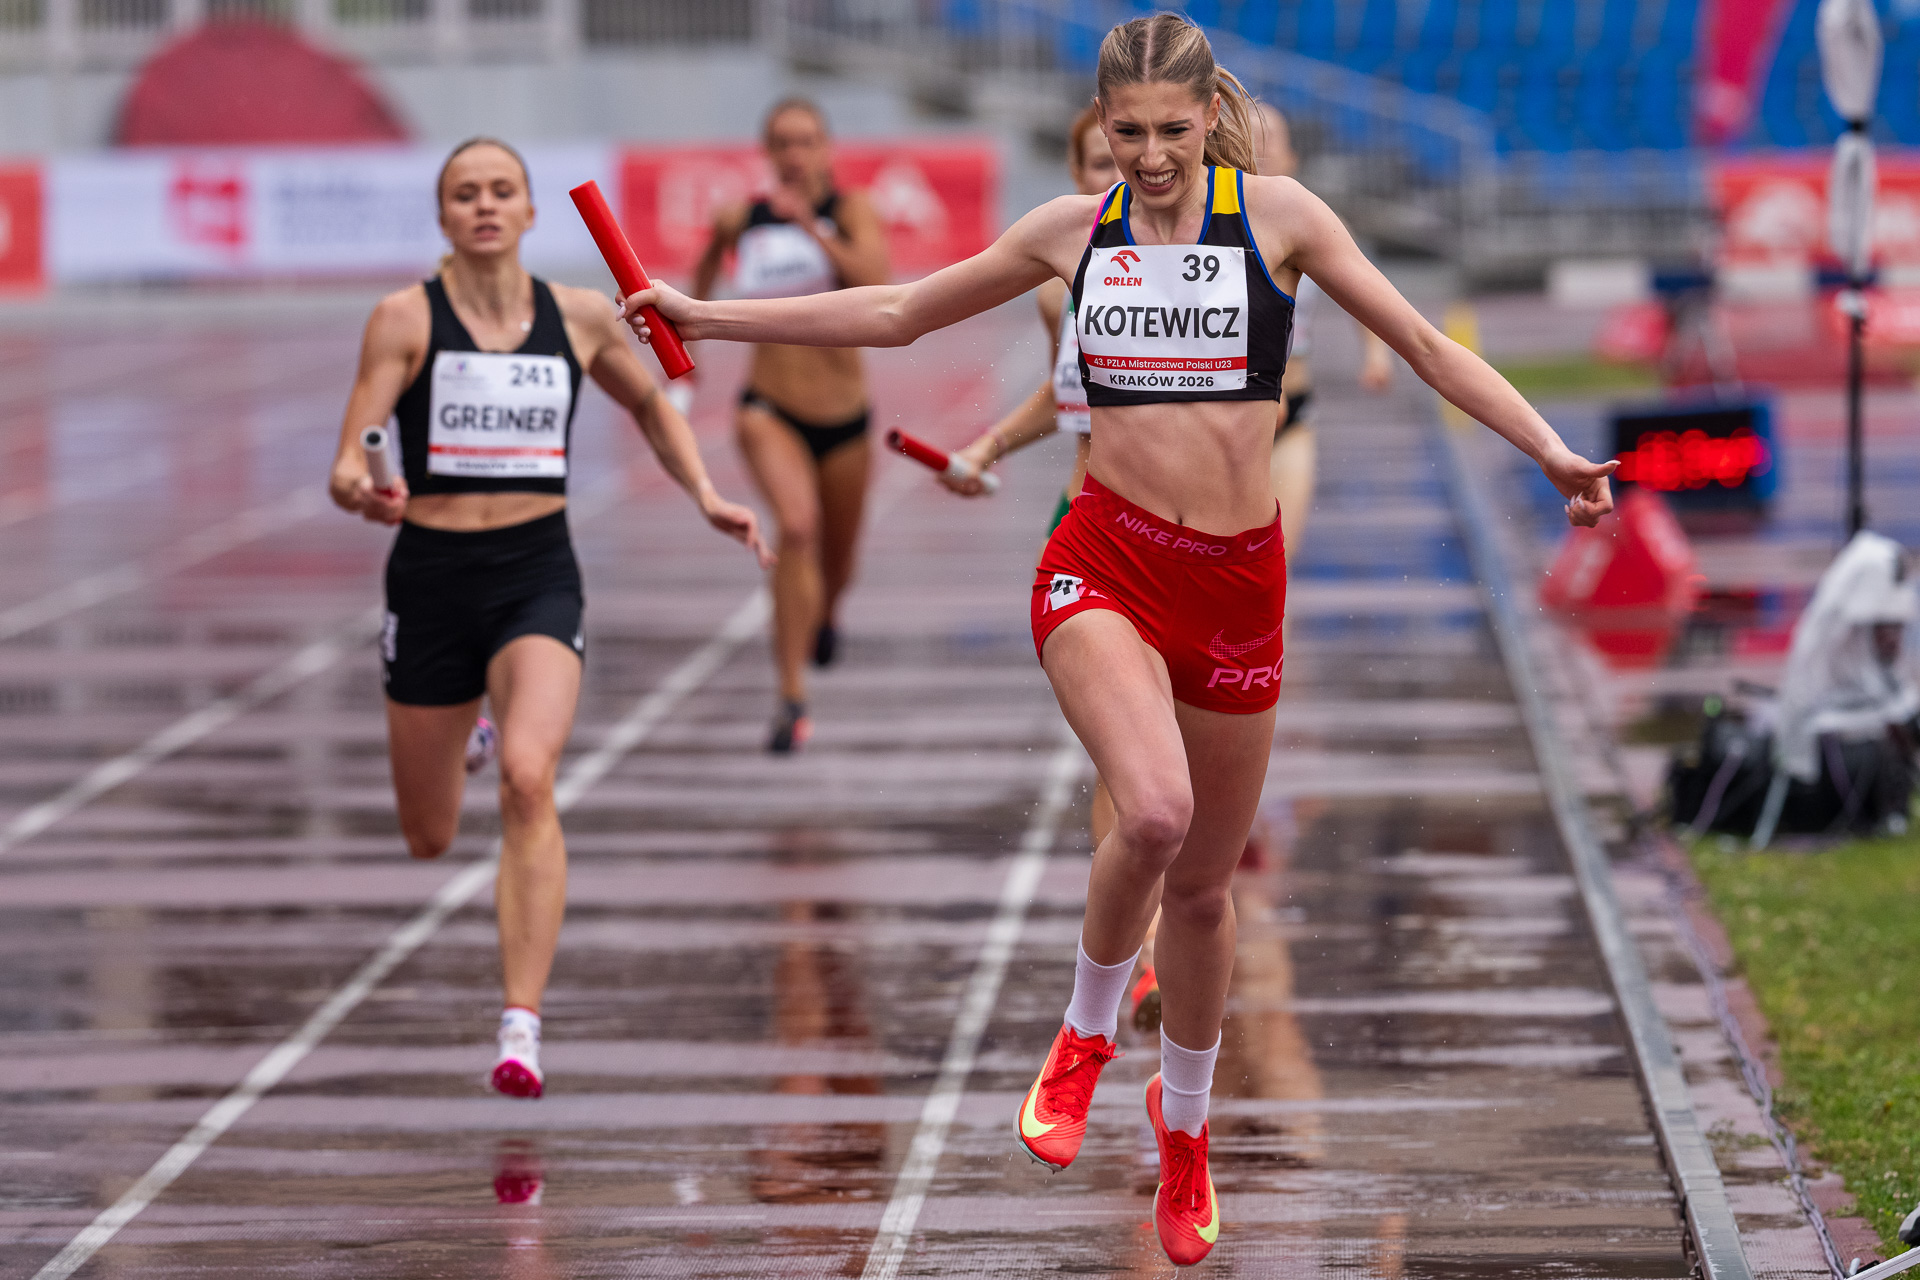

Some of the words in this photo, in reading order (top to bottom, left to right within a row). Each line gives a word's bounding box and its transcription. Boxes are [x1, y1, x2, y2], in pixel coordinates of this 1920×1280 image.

[1182, 254, 1220, 282] 39
[1103, 276, 1142, 287] ORLEN
[1084, 305, 1240, 338] KOTEWICZ
[510, 363, 554, 387] 241
[1093, 357, 1105, 367] 43.
[1107, 359, 1127, 368] PZLA
[1128, 360, 1184, 369] Mistrzostwa
[1186, 360, 1213, 370] Polski
[1215, 359, 1232, 369] U23
[1109, 372, 1174, 387] KRAKÓW
[1178, 376, 1214, 387] 2026
[439, 404, 558, 433] GREINER
[1115, 511, 1174, 546] NIKE
[1172, 537, 1227, 556] PRO
